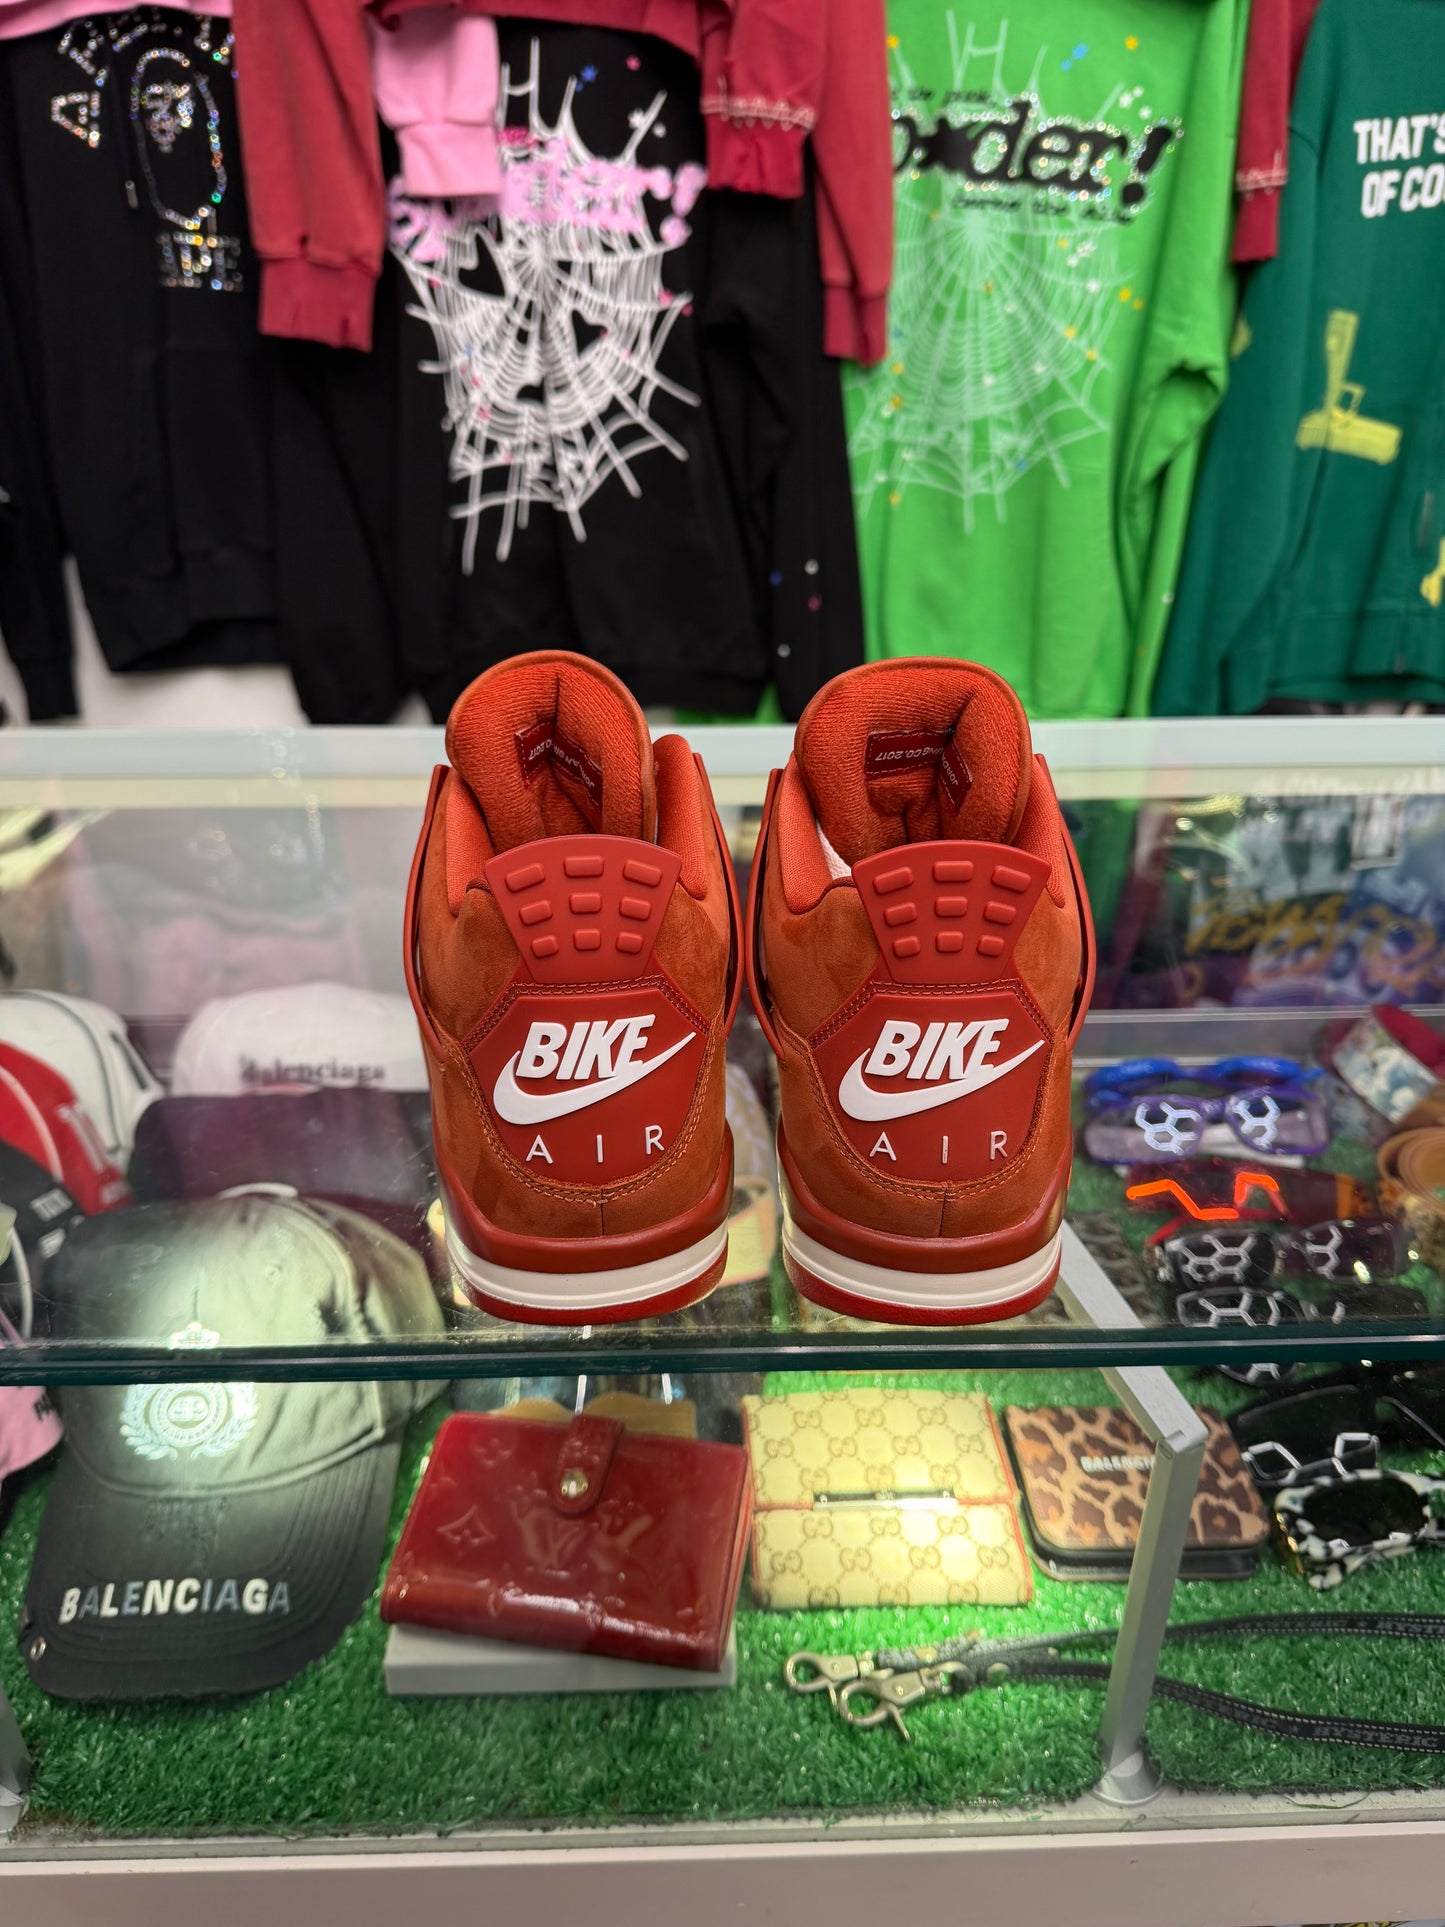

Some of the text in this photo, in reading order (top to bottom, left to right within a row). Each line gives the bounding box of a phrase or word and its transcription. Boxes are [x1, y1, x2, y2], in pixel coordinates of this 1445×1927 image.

[1361, 162, 1445, 218] OF CO
[875, 750, 905, 761] 2017
[515, 1013, 656, 1081] BIKE
[864, 1018, 1010, 1081] BIKE
[525, 1124, 665, 1165] AIR
[869, 1130, 1008, 1165] AIR
[58, 1577, 292, 1625] BALENCIAGA
